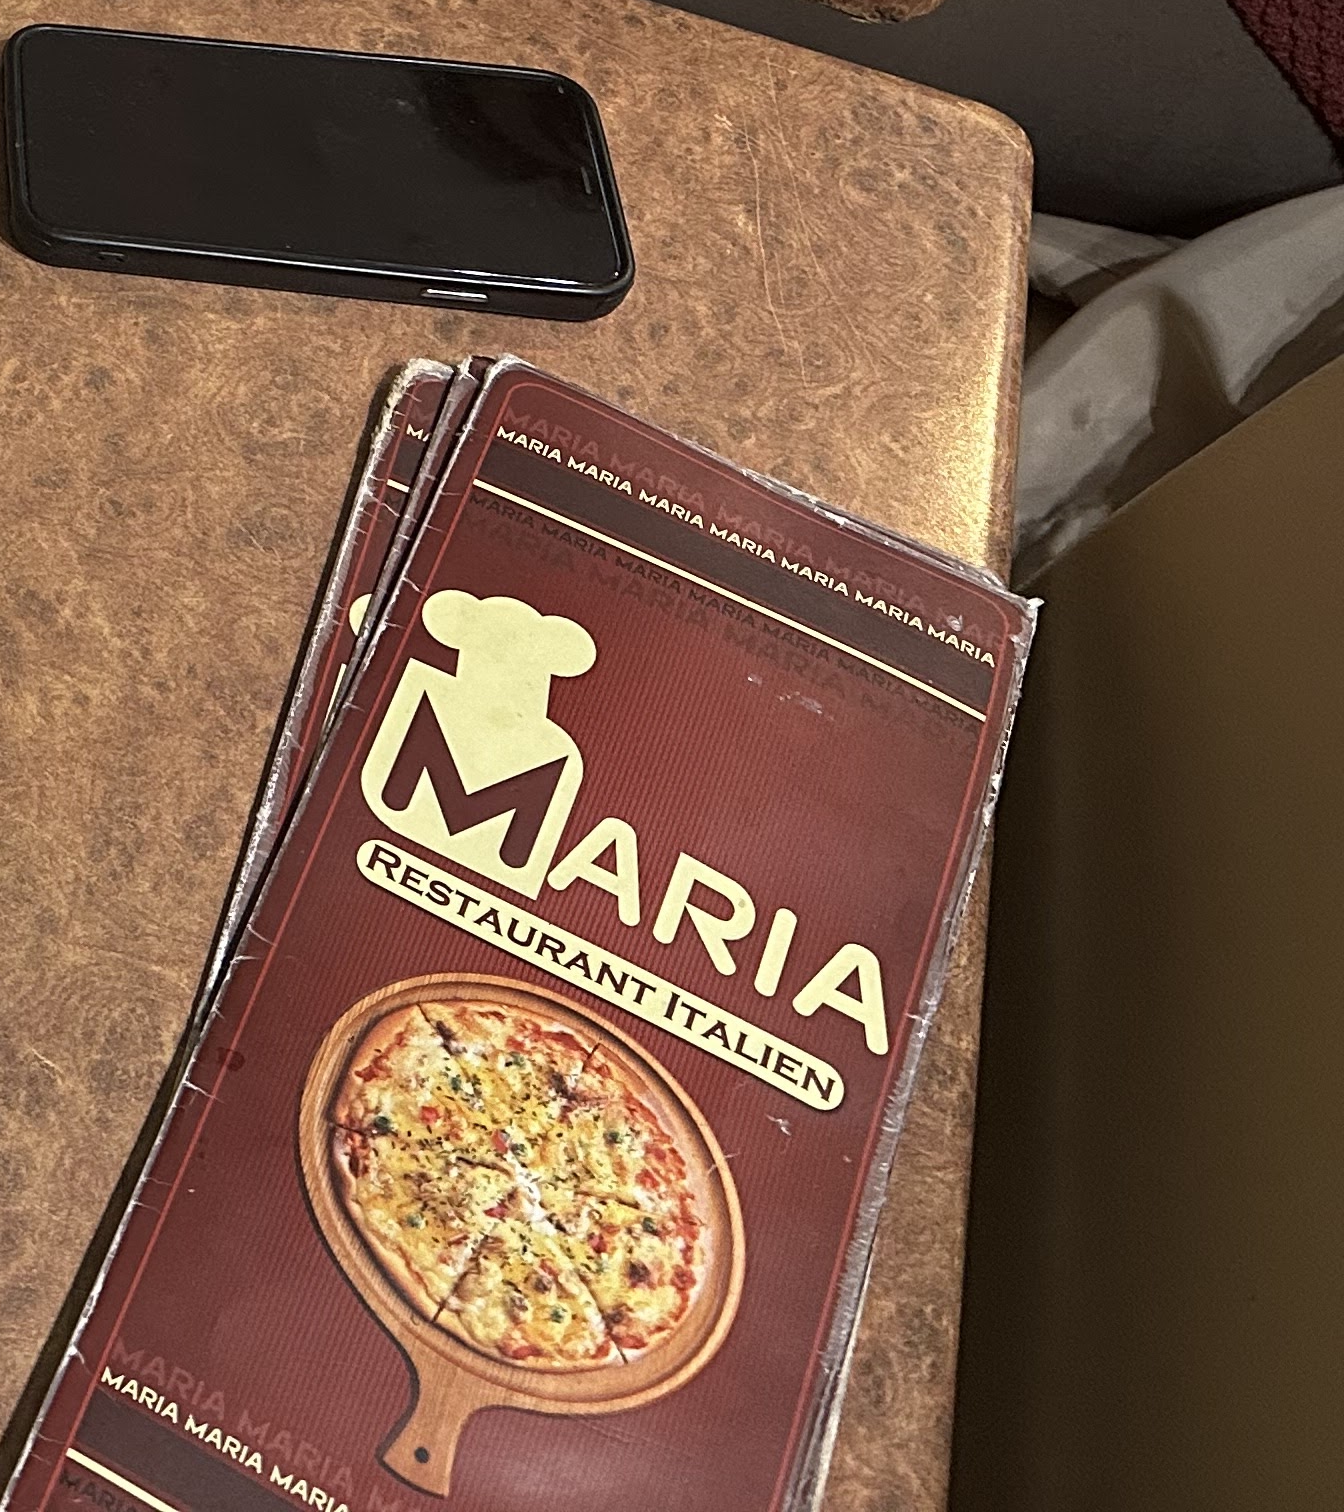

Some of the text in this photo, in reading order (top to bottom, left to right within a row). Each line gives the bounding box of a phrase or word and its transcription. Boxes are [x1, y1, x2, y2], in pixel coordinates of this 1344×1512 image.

[496, 425, 995, 668] MARIA MARIA MARIA MARIA MARIA MARIA MARIA
[613, 554, 679, 595] MARIA
[687, 587, 754, 628] MARIA
[365, 845, 836, 1103] RESTAURANT ITALIEN
[380, 689, 889, 1056] MARIA
[100, 1366, 179, 1424] MARIA
[184, 1414, 262, 1474] MARIA
